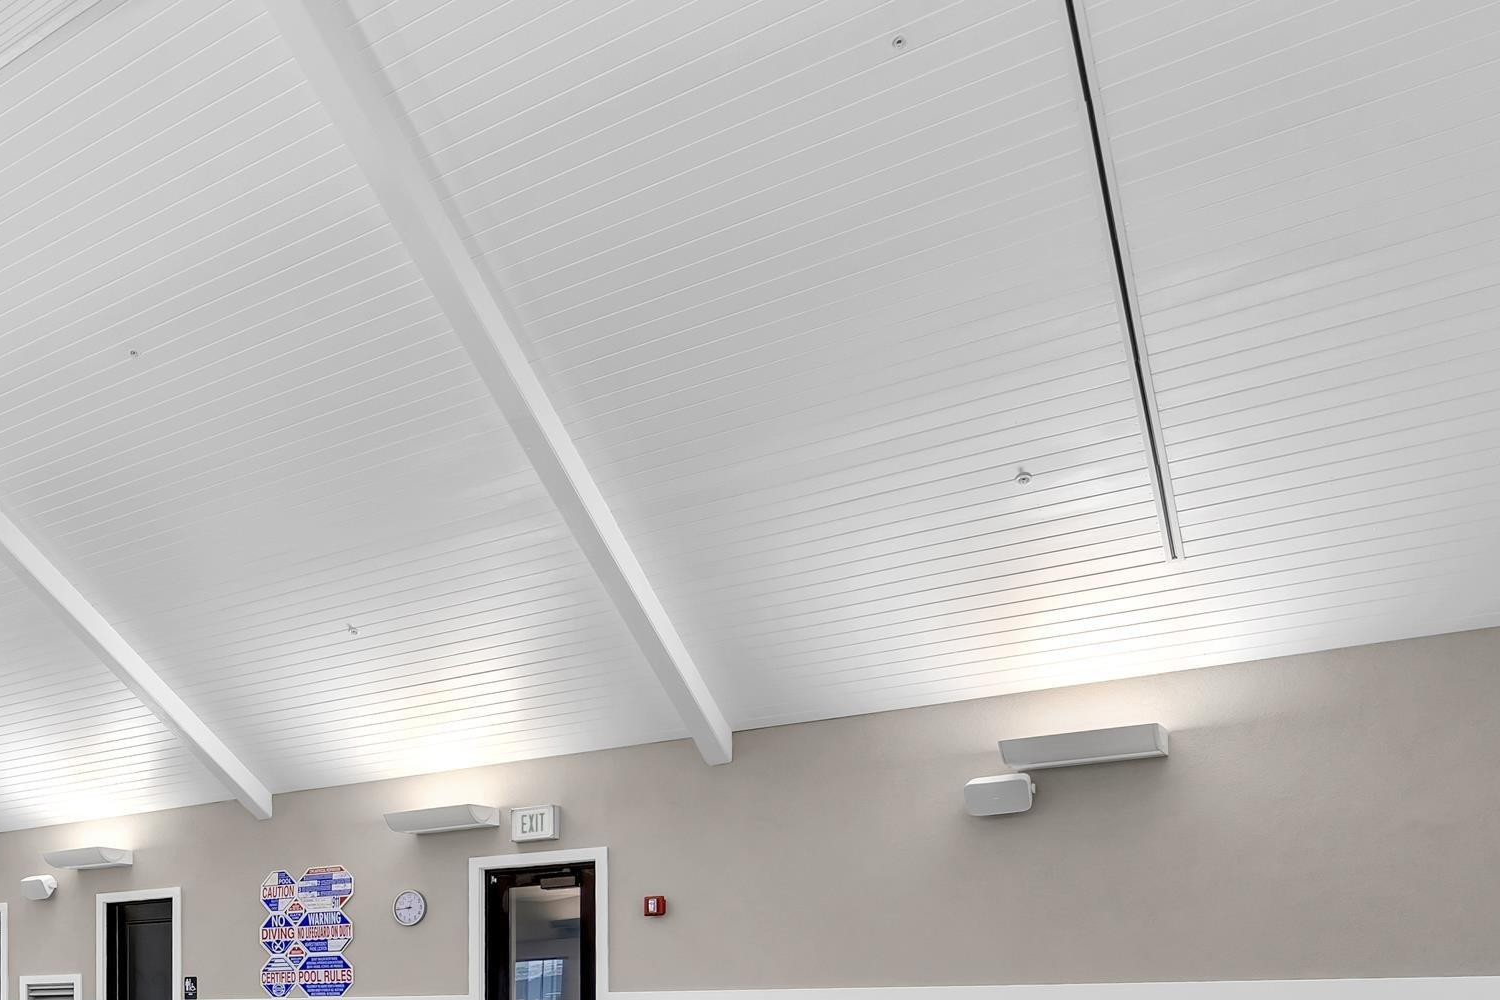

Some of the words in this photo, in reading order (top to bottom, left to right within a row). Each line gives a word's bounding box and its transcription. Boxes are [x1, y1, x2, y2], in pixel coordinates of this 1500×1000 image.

[521, 812, 545, 834] EXIT
[262, 885, 295, 899] CAUTION
[271, 915, 286, 927] NO
[308, 911, 342, 925] WARNING
[261, 927, 295, 940] DIVING
[297, 927, 305, 939] NO
[305, 926, 330, 938] LIFEGUARD
[331, 925, 339, 937] ON
[339, 924, 352, 937] DUTY
[261, 971, 296, 984] CERTIFIED
[298, 970, 322, 982] POOL
[324, 969, 352, 982] RULES
